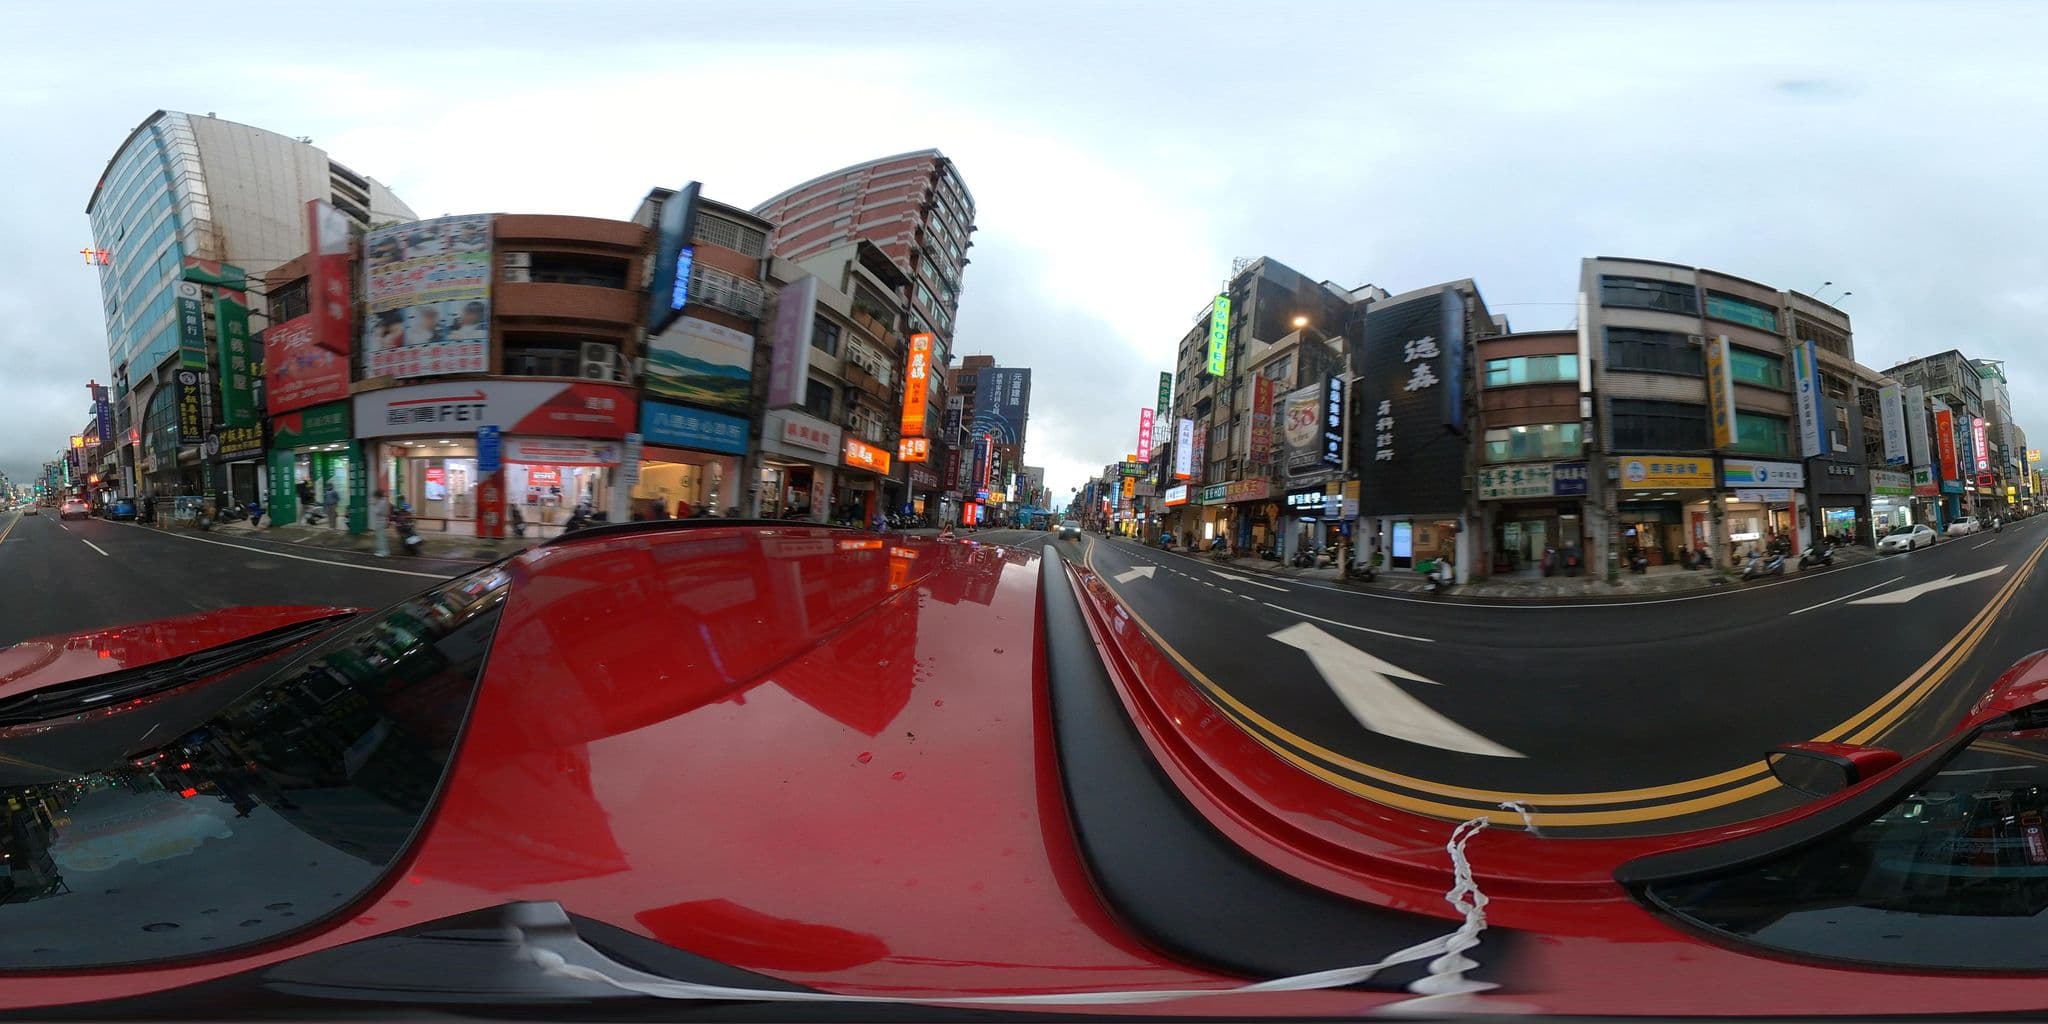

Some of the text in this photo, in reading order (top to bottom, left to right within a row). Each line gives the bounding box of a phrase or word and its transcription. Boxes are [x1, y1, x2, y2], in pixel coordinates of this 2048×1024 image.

[184, 300, 198, 336] 第一銀行
[438, 404, 488, 423] FET
[1376, 399, 1396, 461] 牙科診所
